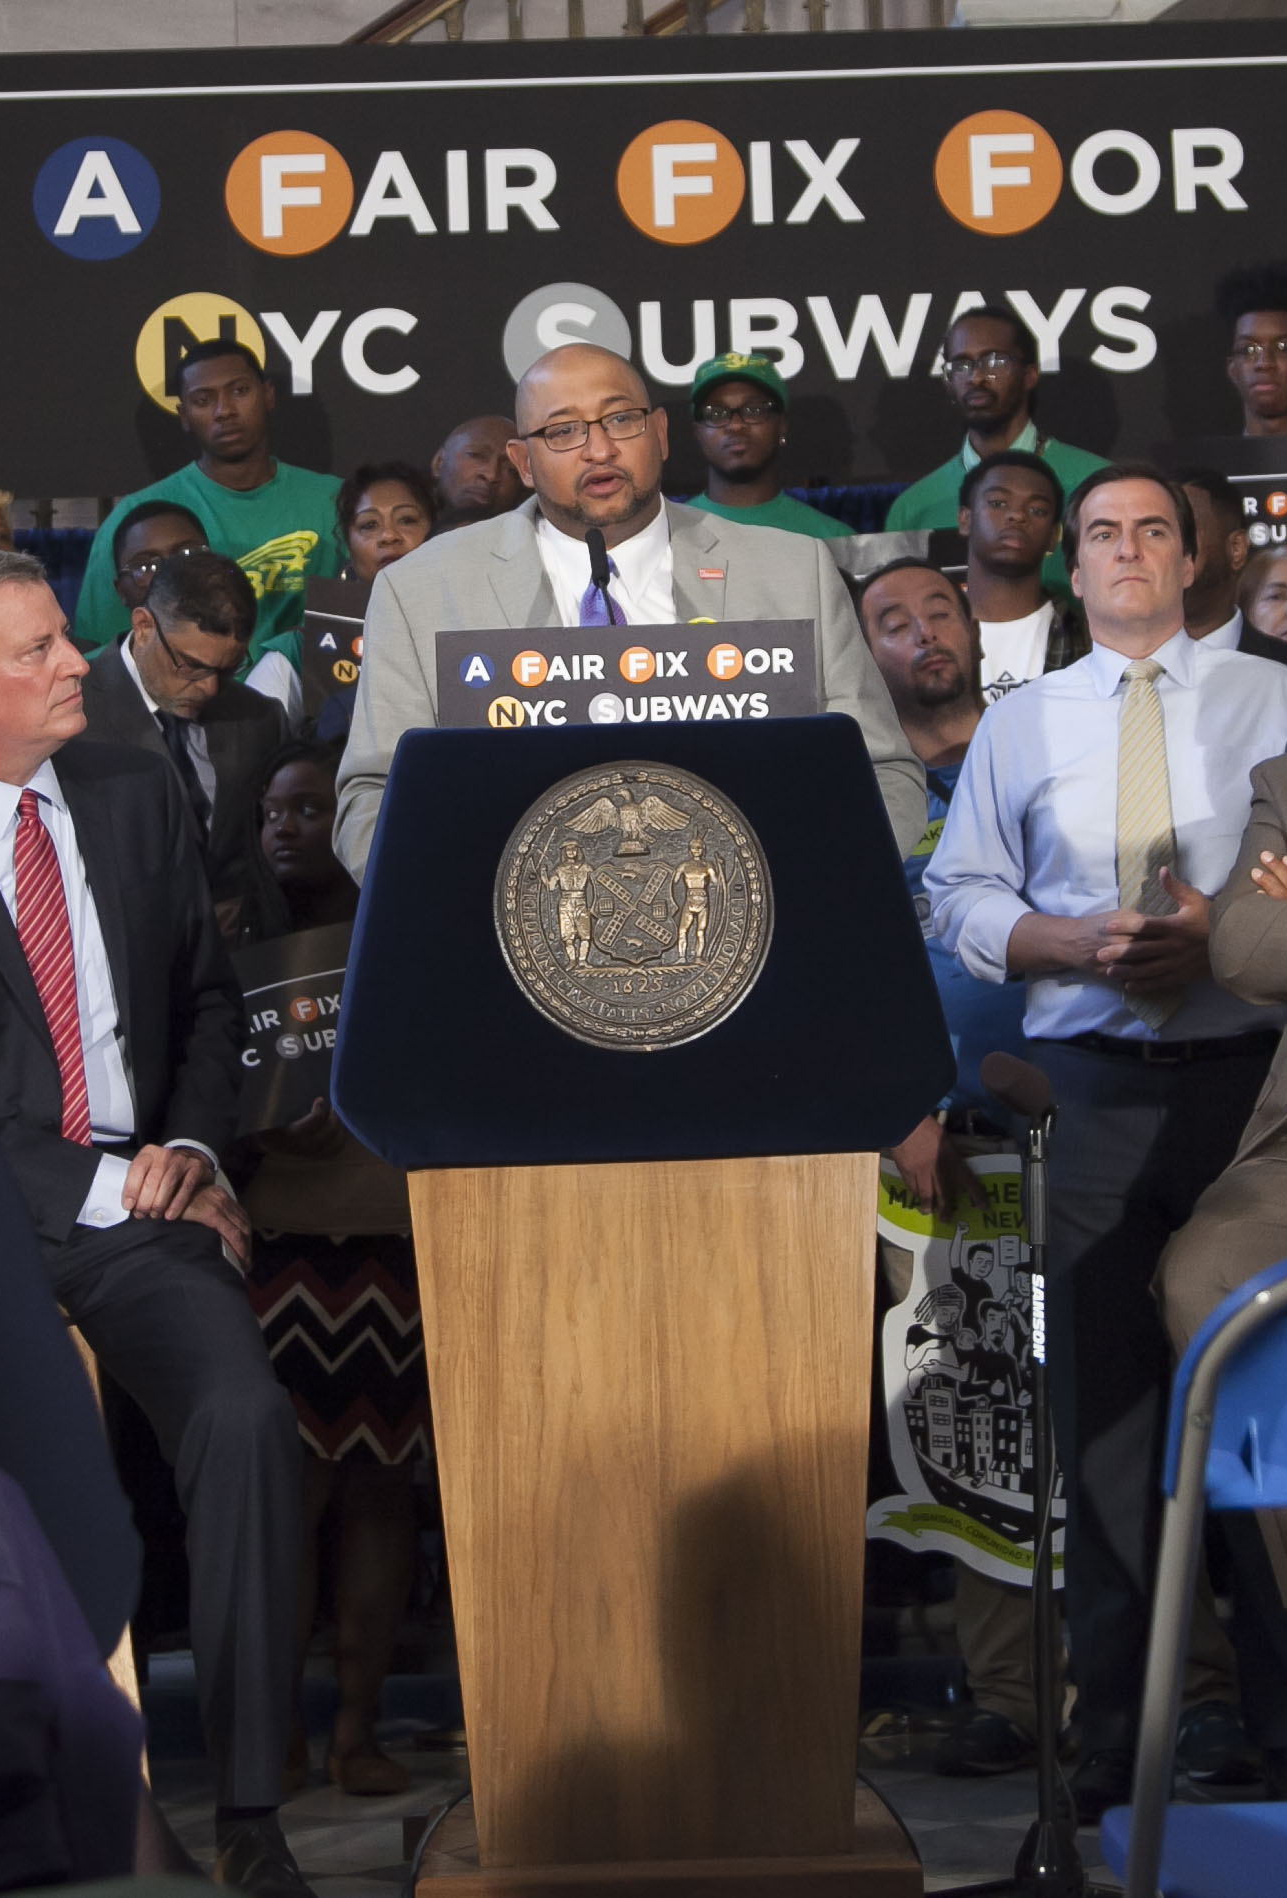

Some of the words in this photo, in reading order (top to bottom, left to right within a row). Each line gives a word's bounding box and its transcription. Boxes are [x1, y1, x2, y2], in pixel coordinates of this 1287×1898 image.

[53, 149, 143, 237] A
[259, 147, 561, 239] FAIR
[650, 136, 867, 228] FIX
[968, 126, 1249, 218] FOR
[163, 307, 421, 398] NYC
[536, 285, 1158, 386] SUBWYS
[319, 632, 337, 650] A
[464, 656, 490, 682] A
[520, 654, 605, 683] FAIR
[628, 651, 689, 679] FIX
[716, 647, 795, 676] FOR
[497, 699, 567, 727] NYC
[597, 693, 770, 724] SUBWAYS
[613, 976, 663, 994] 1625
[296, 993, 341, 1019] FIX
[1031, 1273, 1047, 1361] SAMSON
